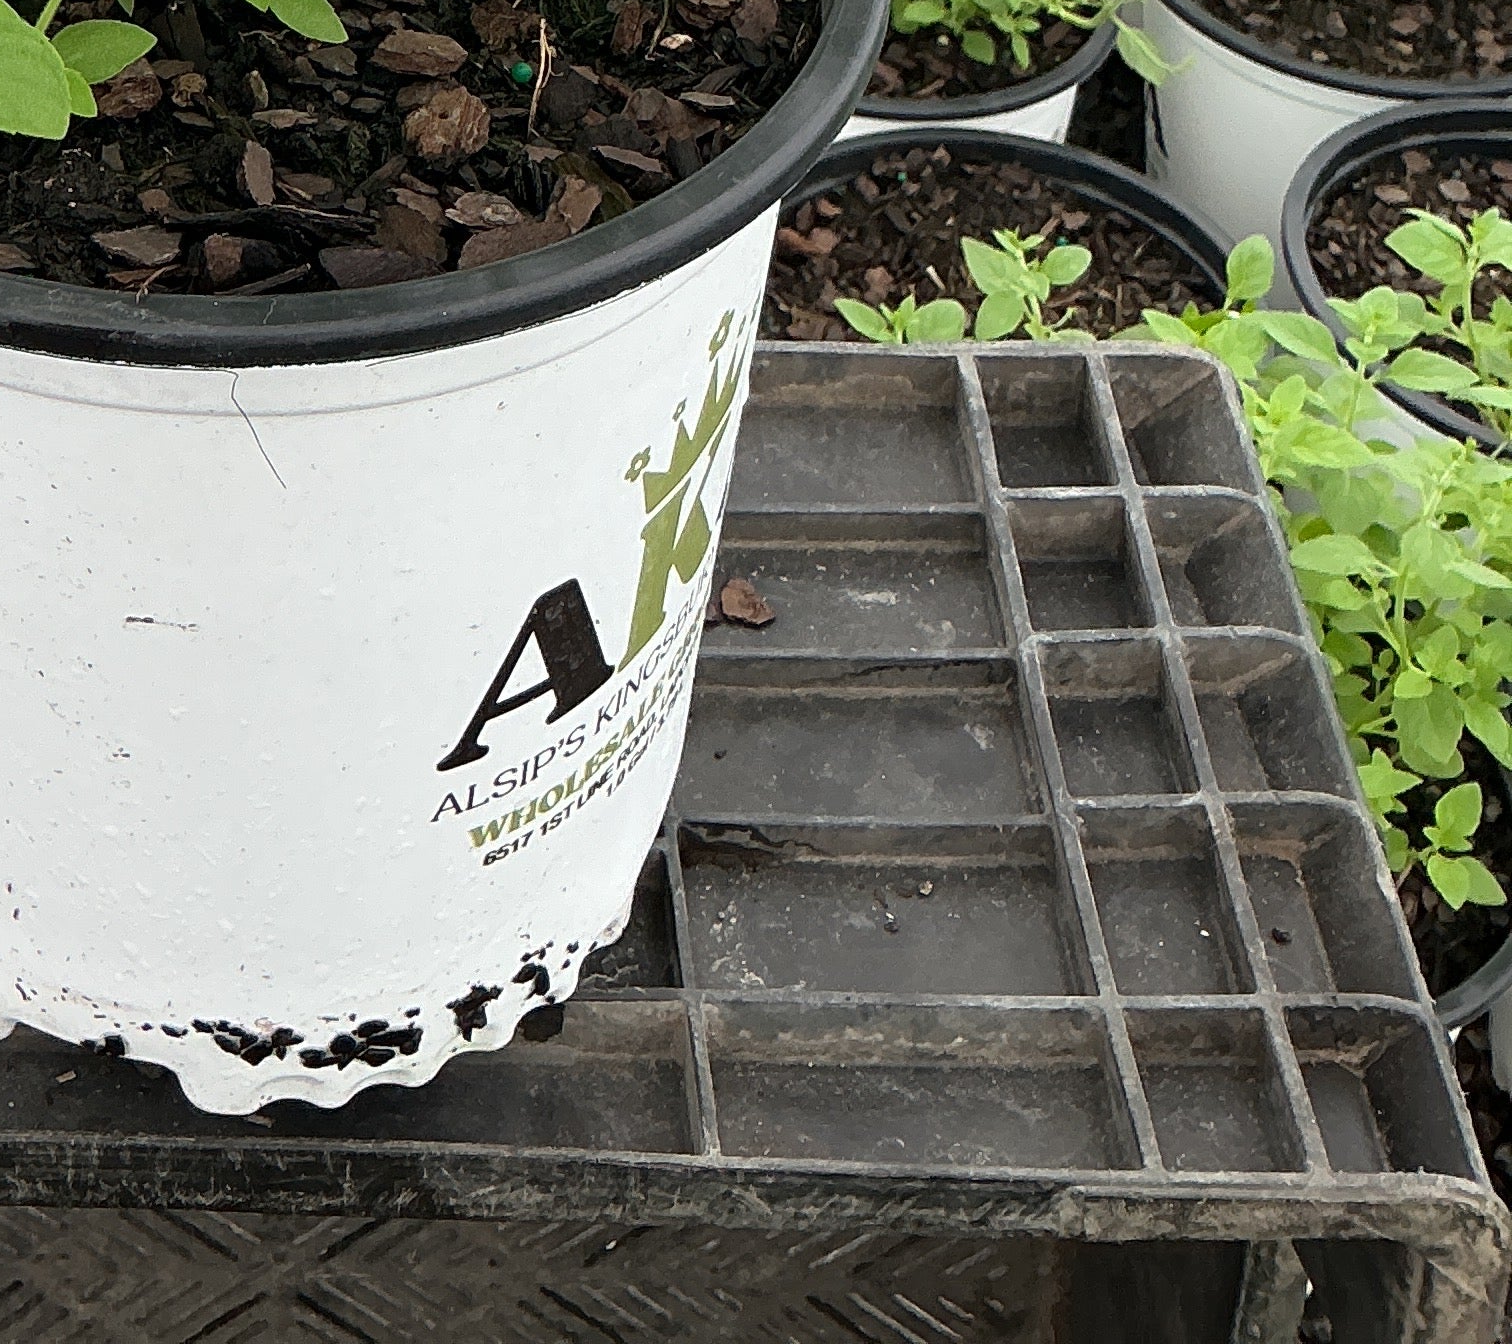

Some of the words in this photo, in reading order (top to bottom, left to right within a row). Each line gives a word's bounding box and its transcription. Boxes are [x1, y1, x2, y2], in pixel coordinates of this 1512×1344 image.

[431, 724, 587, 823] ALSIP'S
[468, 670, 667, 849] WHOLESALE
[482, 829, 535, 867] 6517
[540, 801, 575, 836] 1ST
